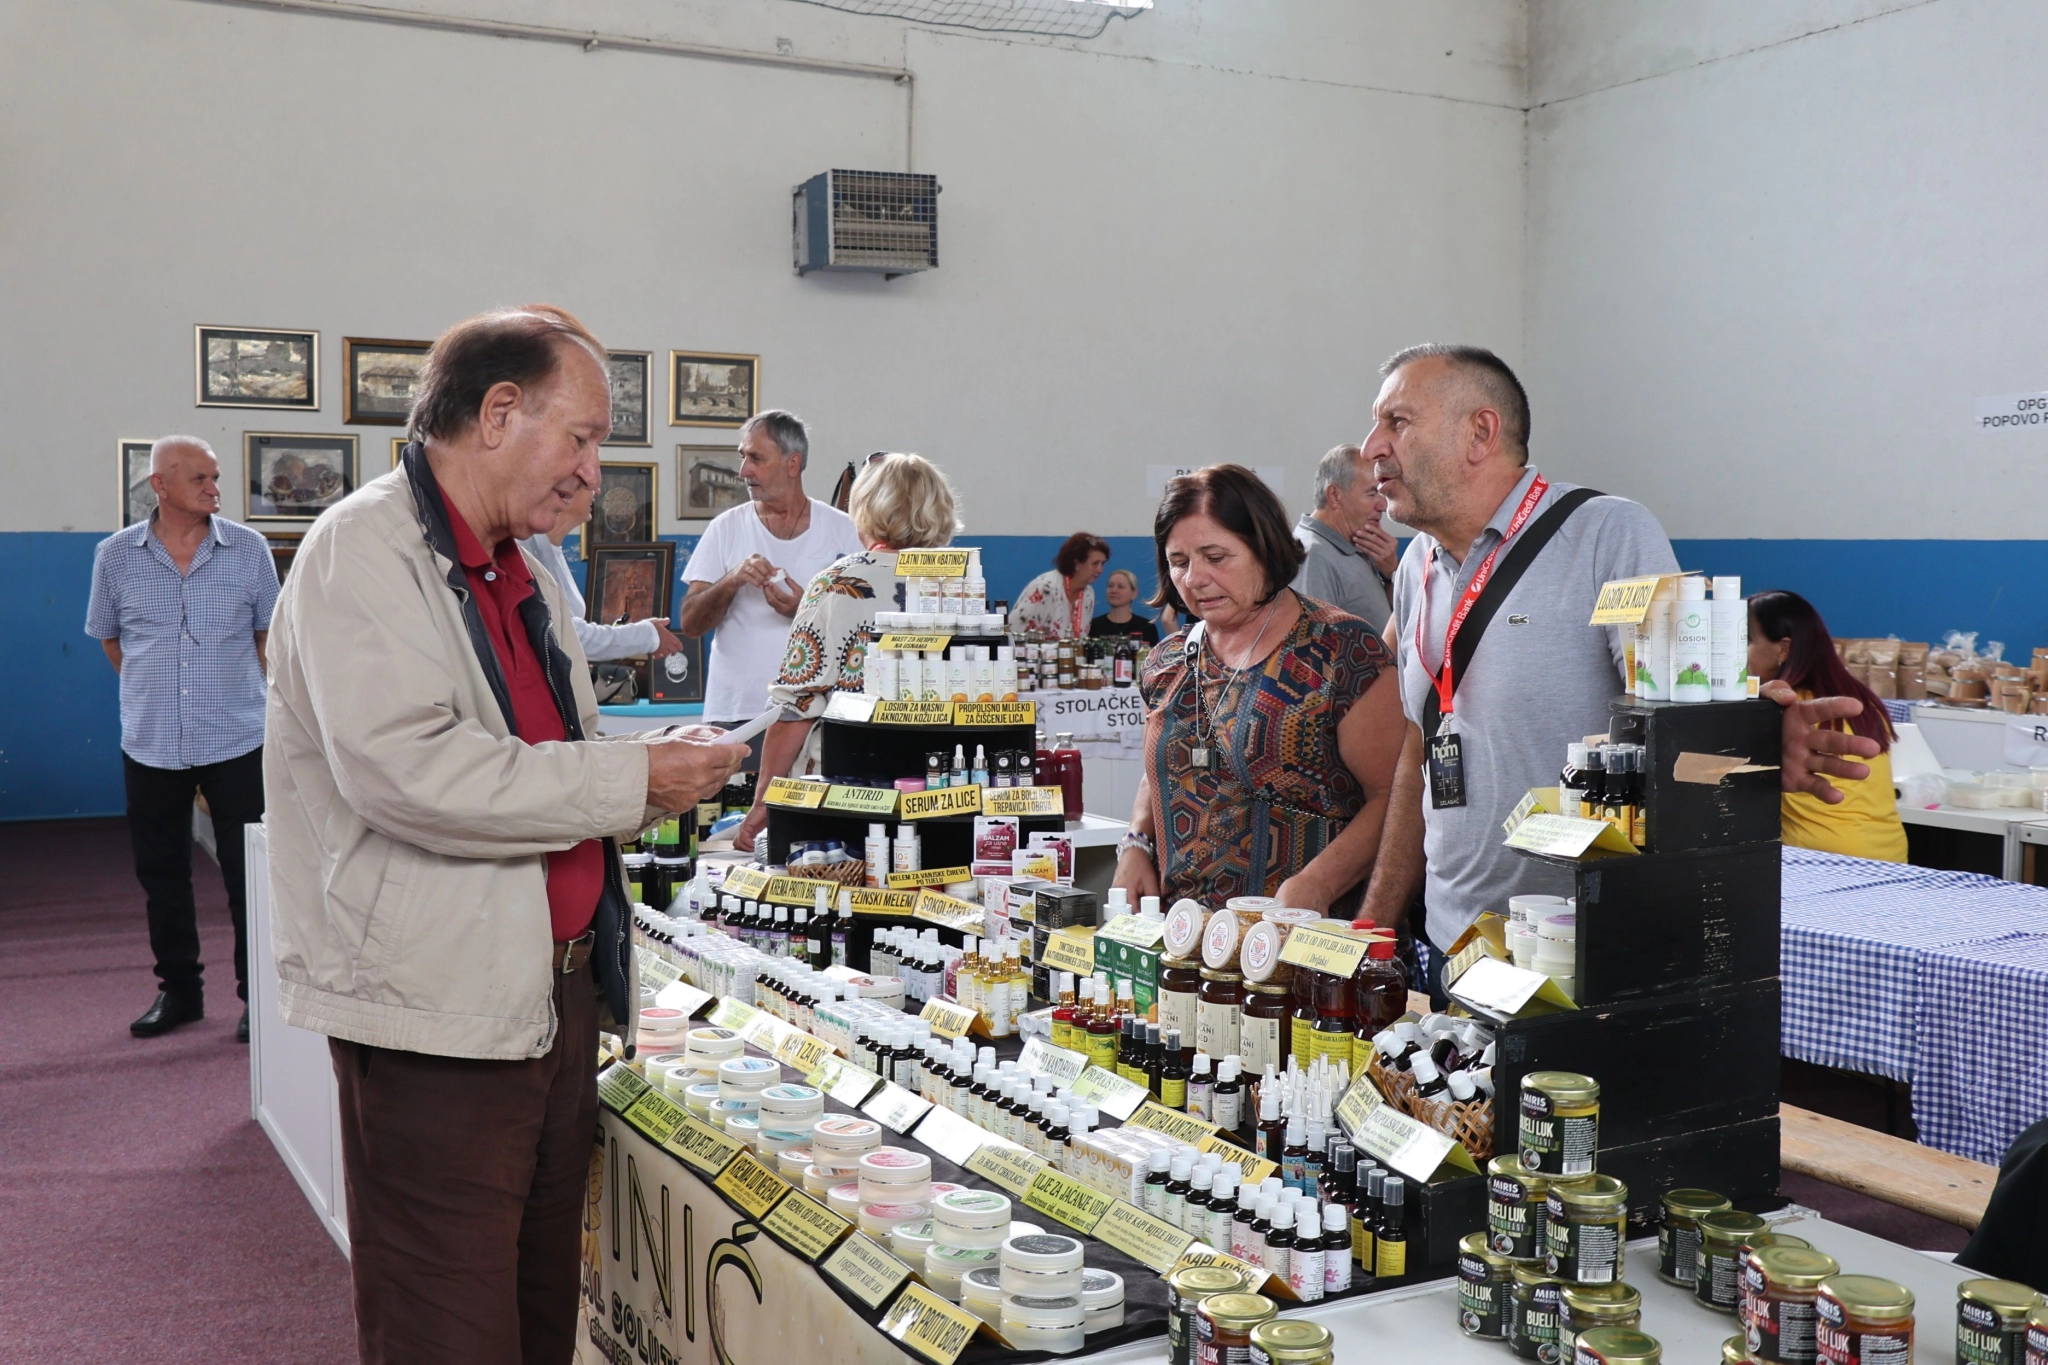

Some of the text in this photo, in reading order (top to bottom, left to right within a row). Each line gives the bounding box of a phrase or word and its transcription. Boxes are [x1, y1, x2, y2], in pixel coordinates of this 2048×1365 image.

[2017, 398, 2047, 411] OPG
[1983, 413, 2040, 428] POPOVO
[1512, 485, 1544, 532] UniCredit Bank
[899, 554, 919, 565] ZLATNI
[919, 554, 937, 565] TONIK
[1597, 585, 1654, 611] LOSION ZA KOSU
[1457, 597, 1474, 621] Bank
[884, 702, 945, 712] LOSION ZA MASNU
[958, 703, 1031, 712] PROPOLISNO MLIJEKO
[1055, 693, 1140, 714] STOLAČKE
[876, 709, 948, 722] I AKNOZNU KOŽU LICA
[965, 711, 1024, 723] ZA ČIŠĆENJE LICA
[1432, 743, 1458, 764] hpm
[771, 779, 786, 788] KREMA
[785, 780, 793, 789] ZA
[842, 788, 884, 801] ANTIRID
[905, 790, 977, 814] SERUM ZA LICE
[989, 790, 1011, 800] SERUM
[1012, 790, 1020, 800] ZA
[1038, 789, 1055, 800] RAST
[993, 800, 1052, 813] TREPAVICA I OBRVA
[889, 874, 911, 882] MELEM
[921, 871, 946, 880] VANJSKE
[946, 868, 967, 876] ČIREVE
[770, 878, 790, 896] KREMA
[789, 880, 808, 899] PROTIV
[851, 890, 915, 908] EŽINSKI MELEM
[1309, 936, 1319, 946] OD
[1337, 942, 1358, 956] JABUKA
[925, 1004, 967, 1034] ULJE SMILJA
[800, 1042, 815, 1060] ZA
[1083, 1067, 1112, 1089] PROPOLIS
[638, 1092, 670, 1117] DNEVNA
[1523, 1092, 1547, 1107] MIRIS
[1132, 1106, 1213, 1144] TINKTURA KANTARION
[1535, 1121, 1554, 1138] LUK
[671, 1123, 698, 1148] KREMA
[693, 1135, 715, 1156] PETE
[976, 1155, 985, 1165] ZA
[1011, 1156, 1027, 1174] BILJNE
[1207, 1140, 1261, 1178] KAPI ZA NOS
[728, 1156, 758, 1185] KREMA
[745, 1169, 766, 1190] OD
[752, 1174, 784, 1205] NEVENA
[1032, 1172, 1109, 1219] ULJE ZA JAČANJE VIDA
[1493, 1179, 1519, 1193] MIRIS
[783, 1197, 806, 1216] KREMA
[800, 1207, 814, 1220] OD
[1489, 1199, 1527, 1223] BIJELI LUK
[806, 1212, 830, 1230] DIVLJE
[822, 1222, 842, 1238] RUŽE
[1112, 1207, 1134, 1222] BILJNE
[1131, 1216, 1149, 1230] KAPI
[1146, 1223, 1167, 1239] BIJELE
[1163, 1232, 1185, 1248] IMELE
[1554, 1224, 1570, 1243] LUK
[866, 1256, 886, 1274] KREMA
[880, 1265, 892, 1278] ZA
[1181, 1251, 1213, 1267] KAPI
[1461, 1256, 1485, 1272] MIRIS
[1475, 1286, 1492, 1302] LUK
[1535, 1288, 1560, 1300] MIRI
[1754, 1297, 1770, 1318] LUK
[1816, 1296, 1841, 1316] MIRIS
[1963, 1303, 1993, 1321] MIRIS
[612, 1291, 679, 1365] SOLUT
[1526, 1309, 1554, 1328] BIJELI
[590, 1316, 614, 1361] since
[920, 1306, 953, 1346] PROTIV
[937, 1321, 970, 1358] BORA
[1830, 1330, 1850, 1353] LUK
[1958, 1324, 2003, 1354] BIJELI LUK
[2028, 1329, 2048, 1347] MIRI
[1203, 1344, 1219, 1363] LUK
[1577, 1350, 1600, 1365] MIRIS
